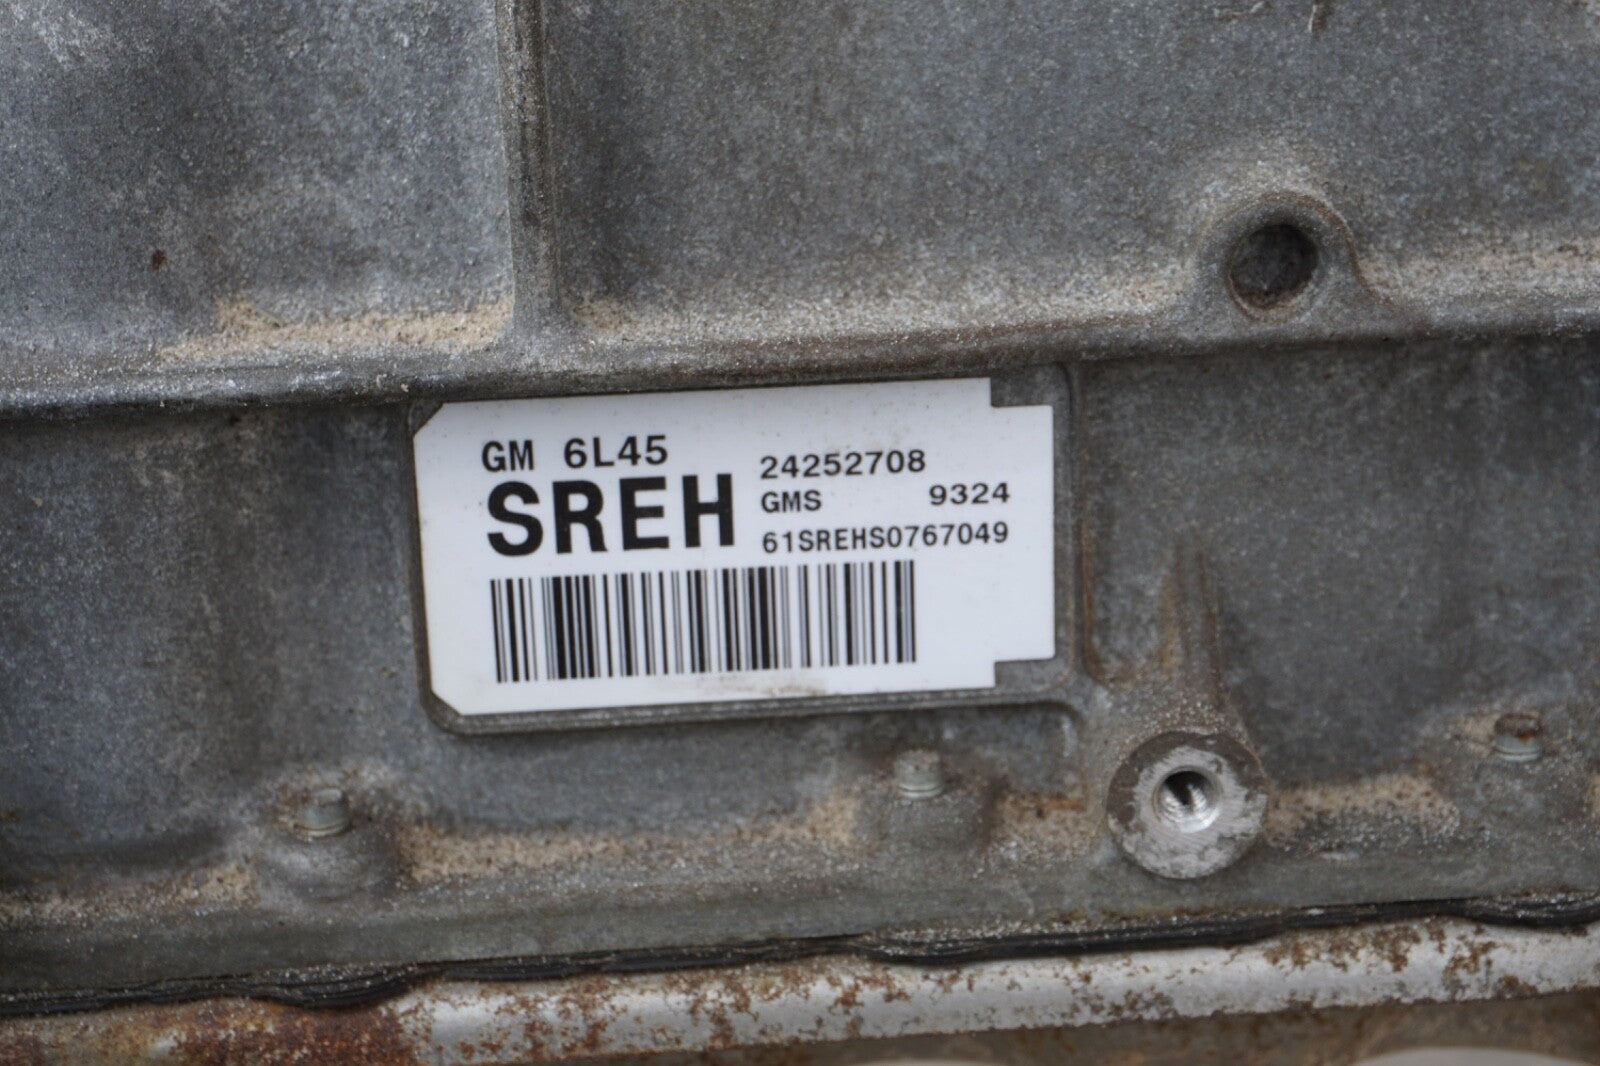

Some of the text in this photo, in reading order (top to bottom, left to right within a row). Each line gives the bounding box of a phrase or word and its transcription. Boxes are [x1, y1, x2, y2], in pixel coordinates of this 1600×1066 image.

[482, 434, 669, 473] GM 6L45
[760, 449, 926, 480] 24252708
[761, 482, 1010, 513] GMS 9324
[487, 473, 735, 557] SREH
[762, 521, 1009, 554] 61SREHS0767049
